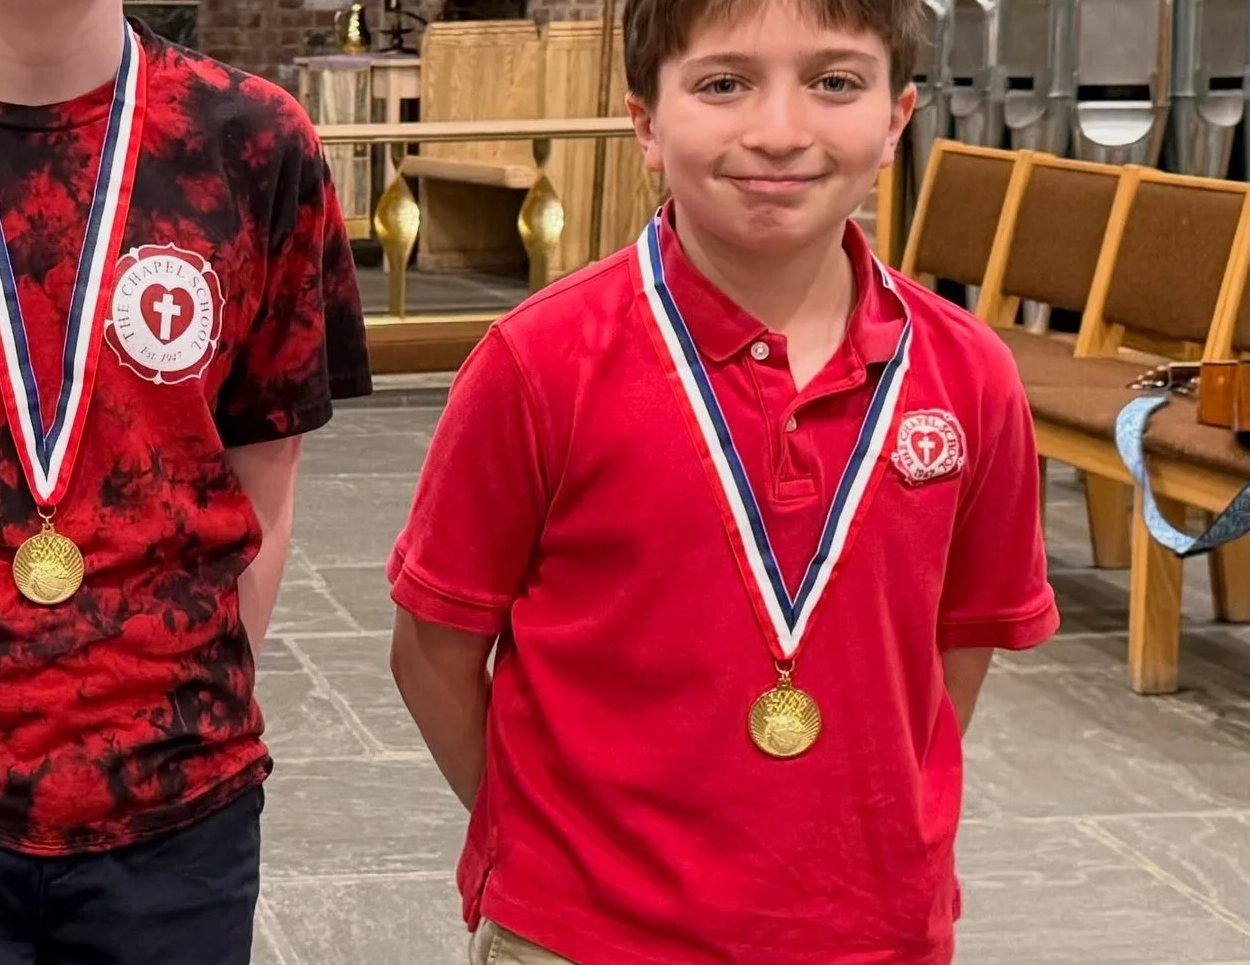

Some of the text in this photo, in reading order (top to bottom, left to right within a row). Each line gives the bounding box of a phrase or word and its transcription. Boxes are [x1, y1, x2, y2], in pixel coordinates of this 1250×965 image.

[117, 260, 210, 351] THE CHAPEL SCHOOL
